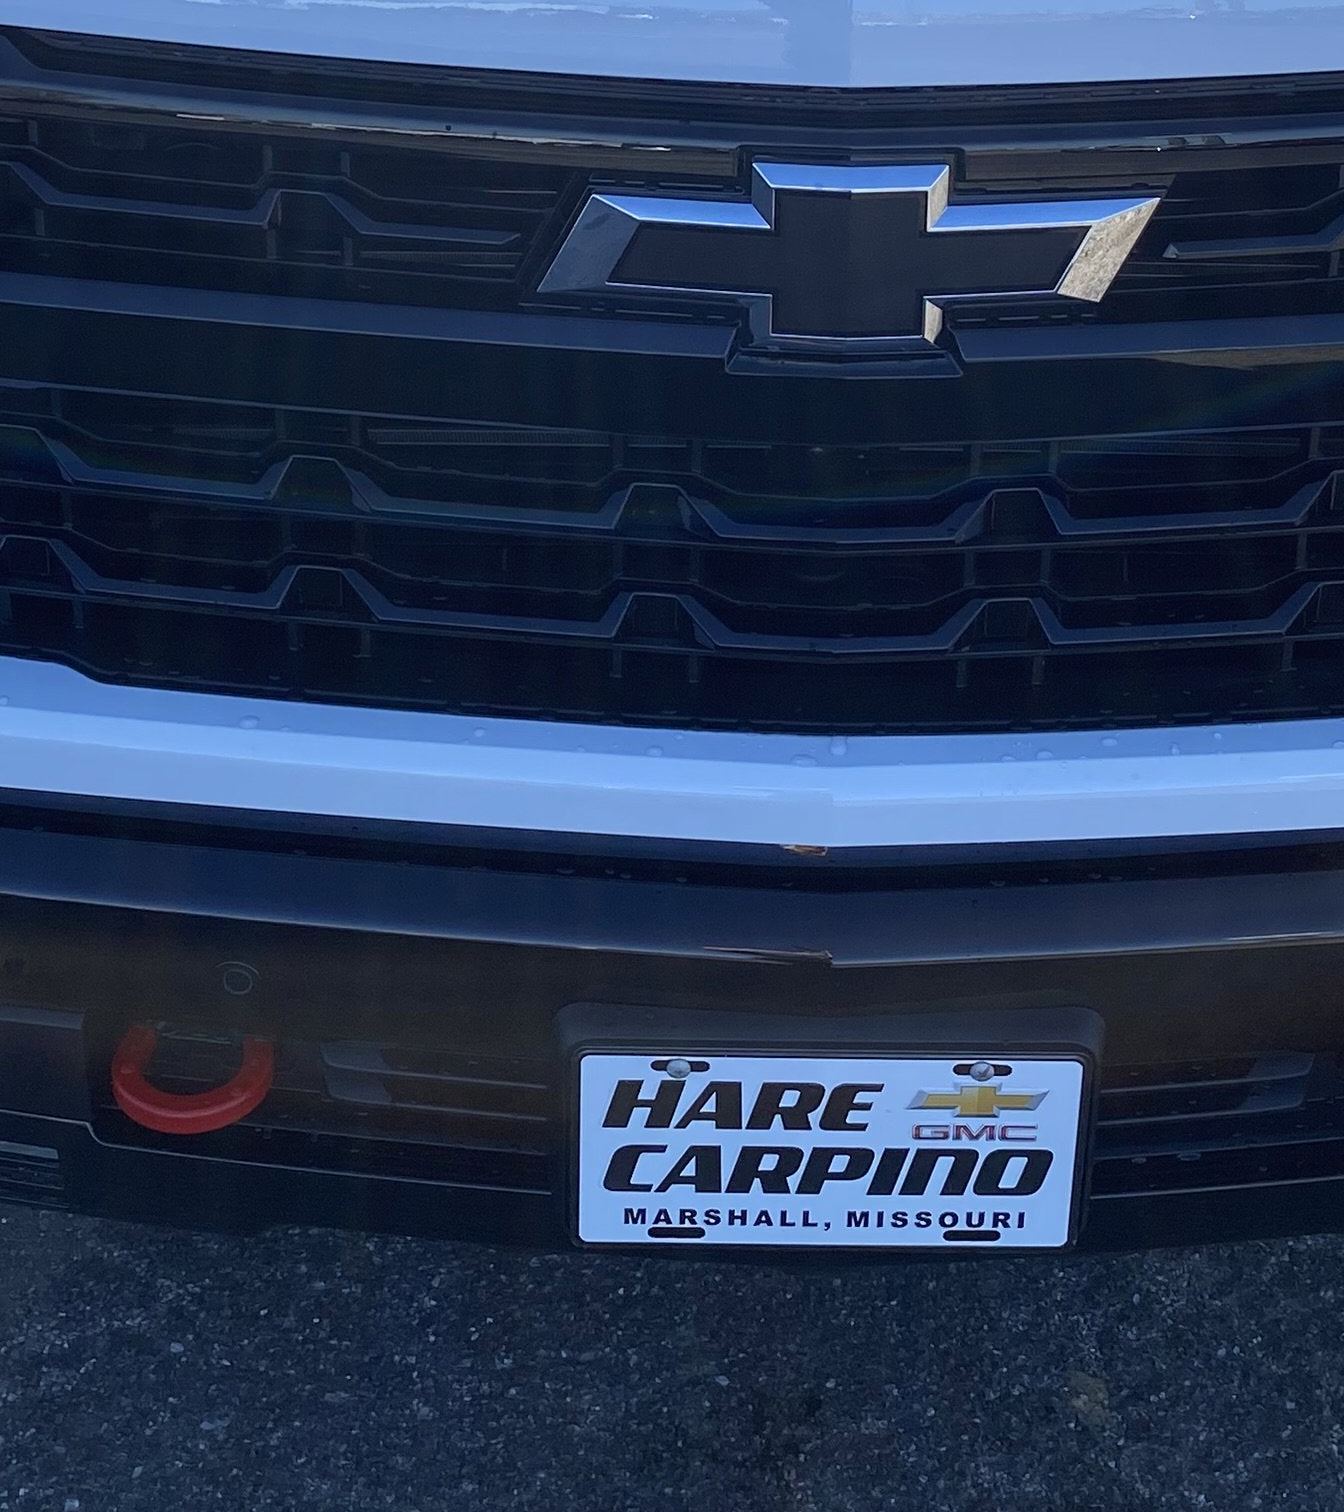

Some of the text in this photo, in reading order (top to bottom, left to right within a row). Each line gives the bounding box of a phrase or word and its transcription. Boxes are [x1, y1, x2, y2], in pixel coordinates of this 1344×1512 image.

[601, 1079, 885, 1131] HARE
[911, 1123, 1038, 1141] GMC
[602, 1144, 1054, 1196] CARPINO
[623, 1207, 1026, 1231] MARSHALL, MISSOURI
